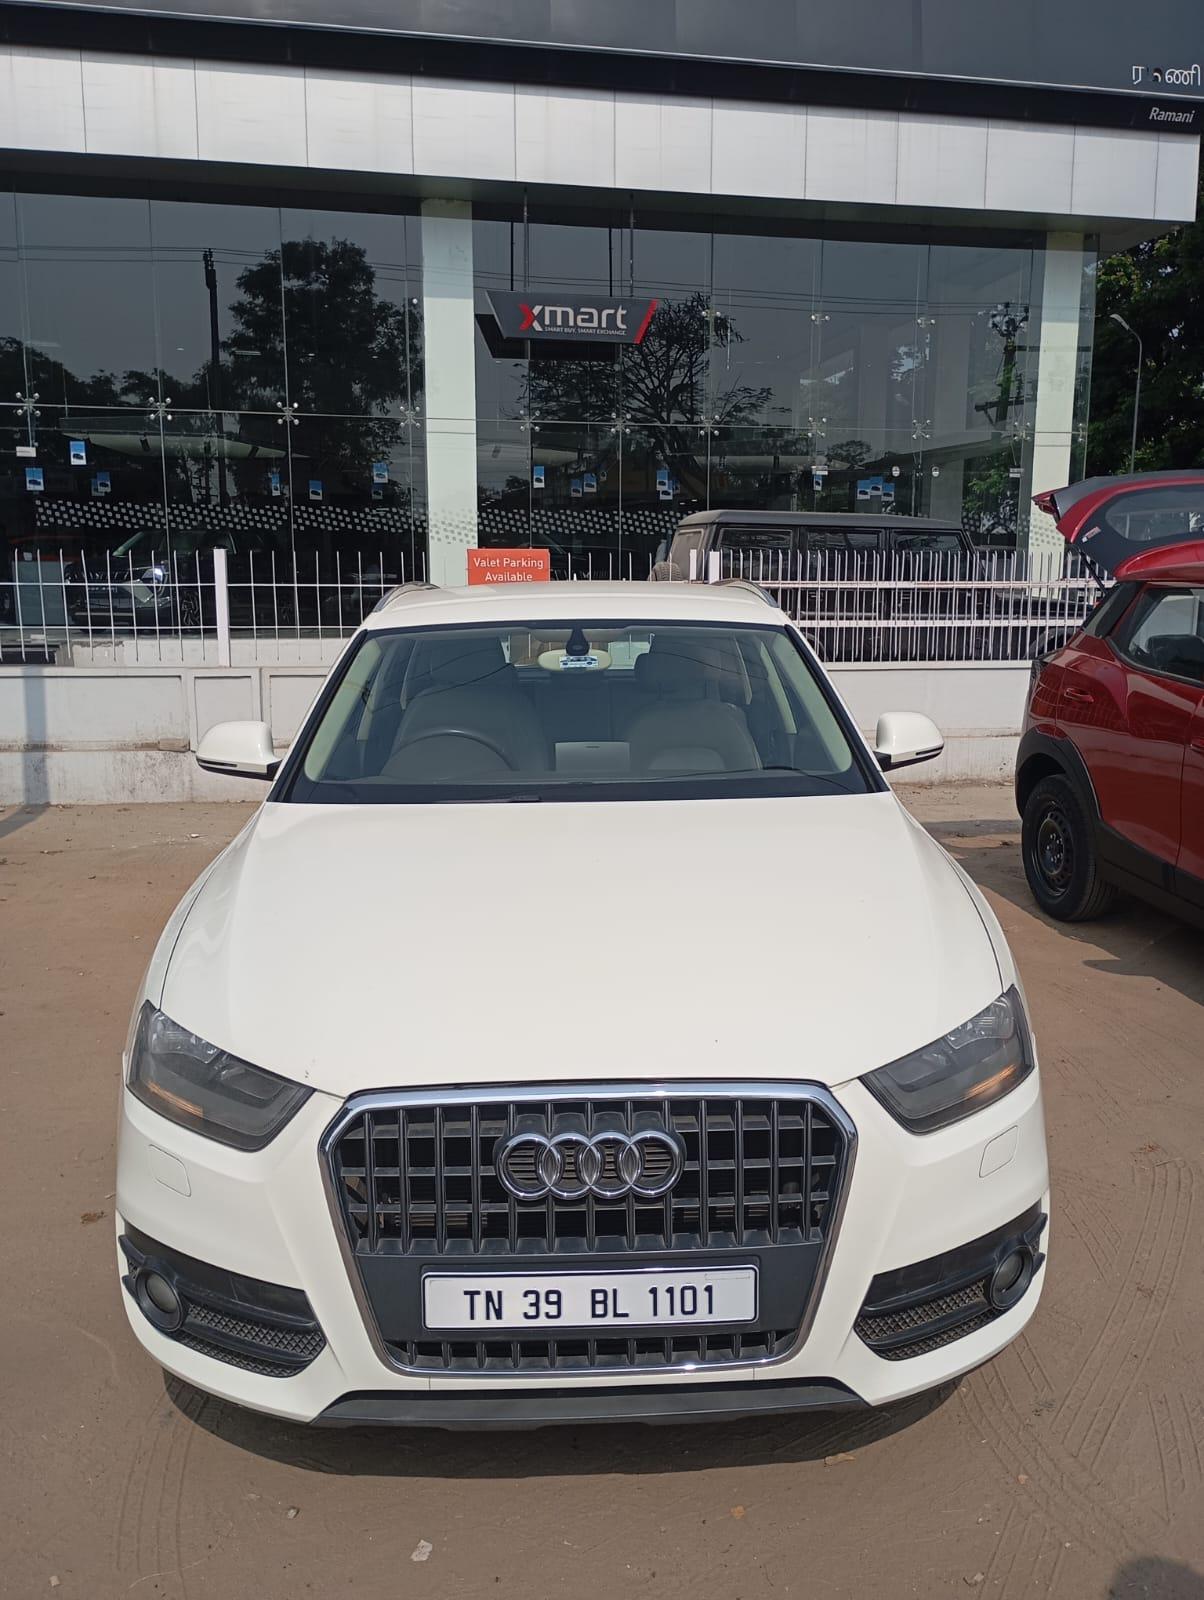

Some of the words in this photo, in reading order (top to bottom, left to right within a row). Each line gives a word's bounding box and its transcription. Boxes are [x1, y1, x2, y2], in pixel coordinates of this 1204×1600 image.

[1149, 106, 1196, 123] Ramani
[473, 557, 501, 568] Valet
[503, 557, 544, 570] Parking
[485, 571, 533, 582] Available
[463, 1290, 503, 1321] TN
[522, 1289, 563, 1320] 39
[590, 1288, 630, 1319] BL
[648, 1284, 714, 1317] 1101
